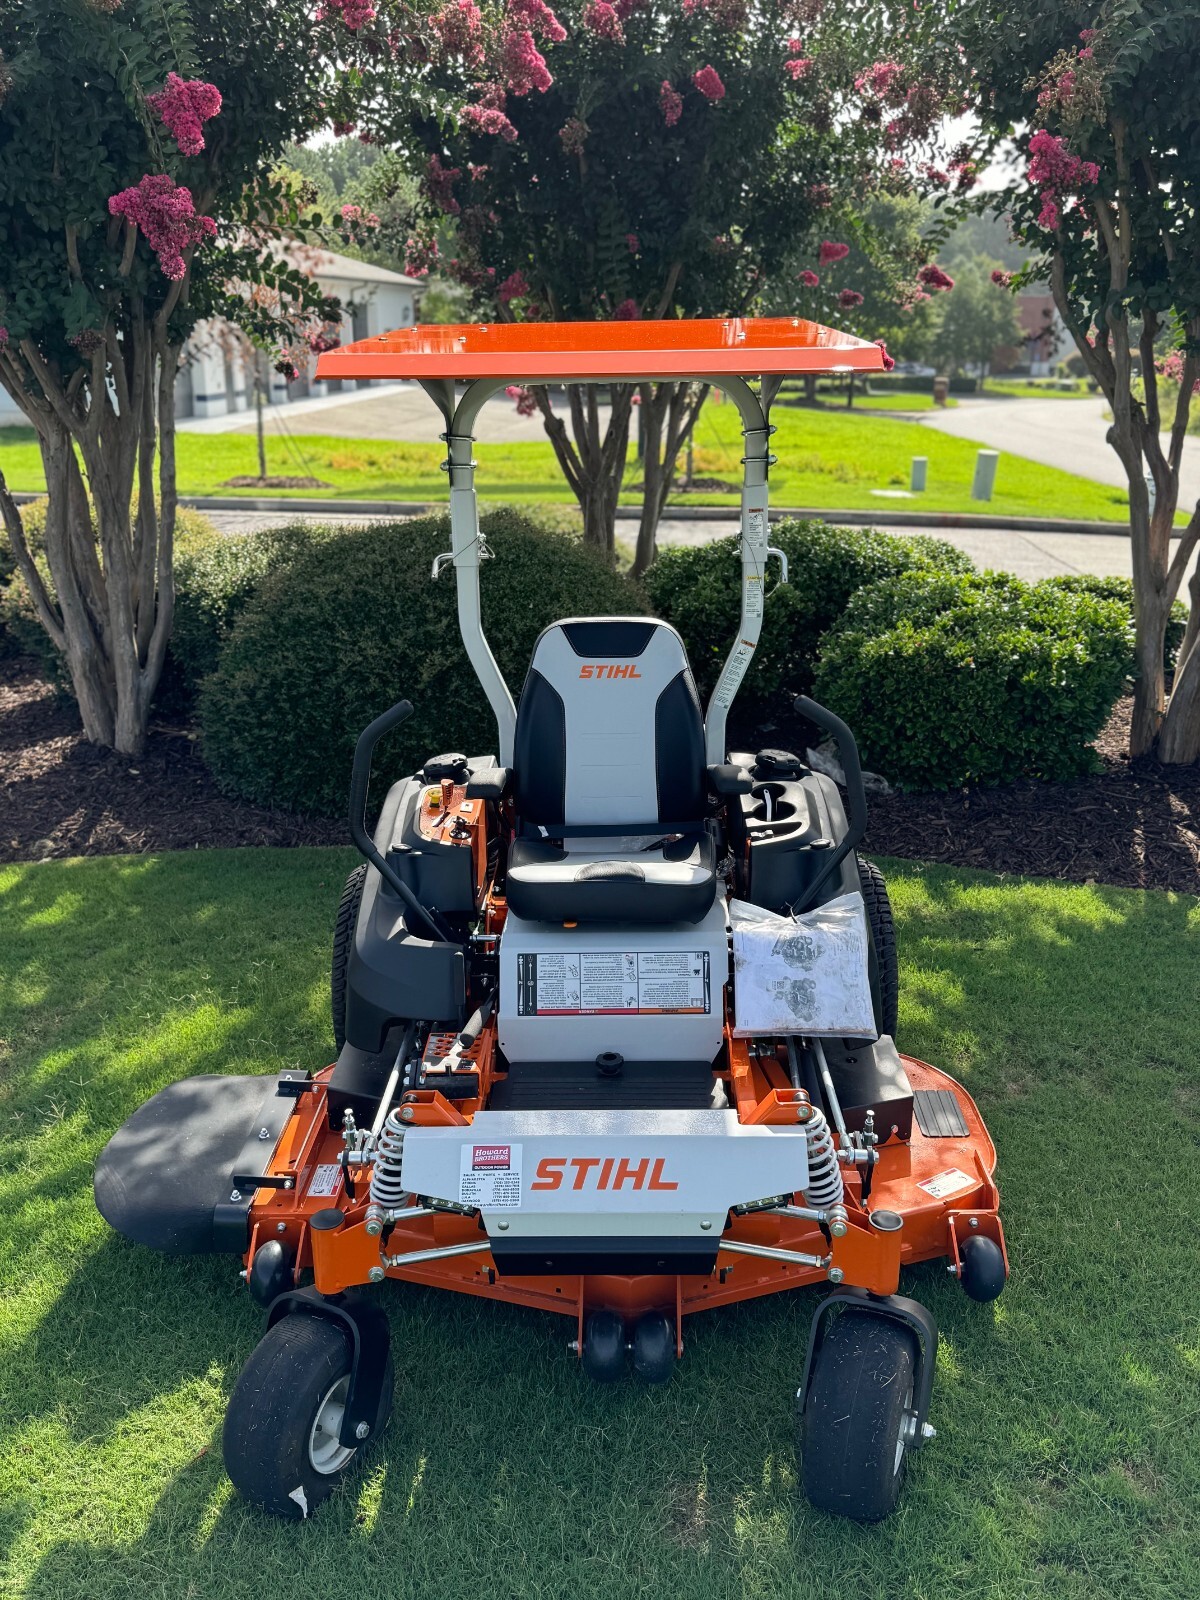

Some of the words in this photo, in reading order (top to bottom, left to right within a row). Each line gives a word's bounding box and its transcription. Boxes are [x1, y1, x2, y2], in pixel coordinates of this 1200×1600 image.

[578, 664, 642, 679] STIHL
[475, 1148, 508, 1156] Howard
[530, 1157, 679, 1191] STIHL
